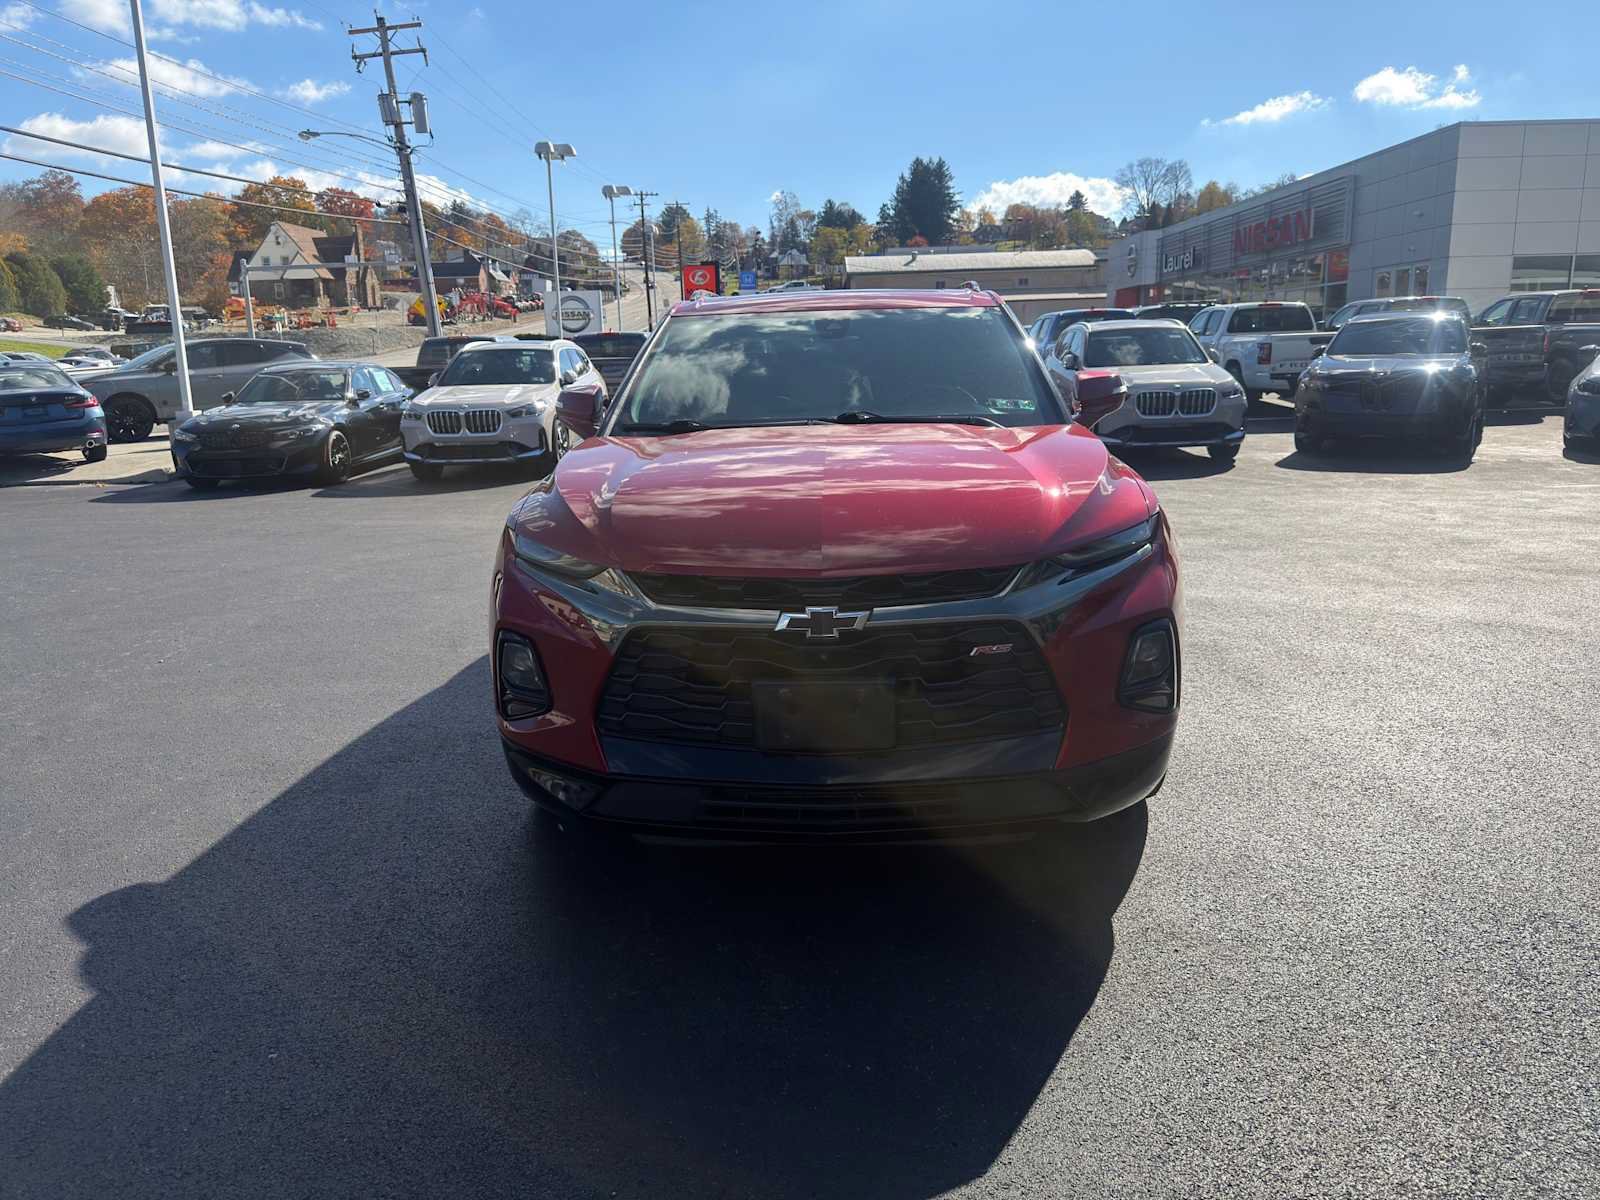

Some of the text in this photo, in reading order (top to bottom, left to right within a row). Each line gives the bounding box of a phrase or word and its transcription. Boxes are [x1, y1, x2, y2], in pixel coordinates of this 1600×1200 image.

[1232, 208, 1314, 259] NISSAN
[1162, 247, 1195, 273] Laurel
[970, 643, 1014, 656] RS
